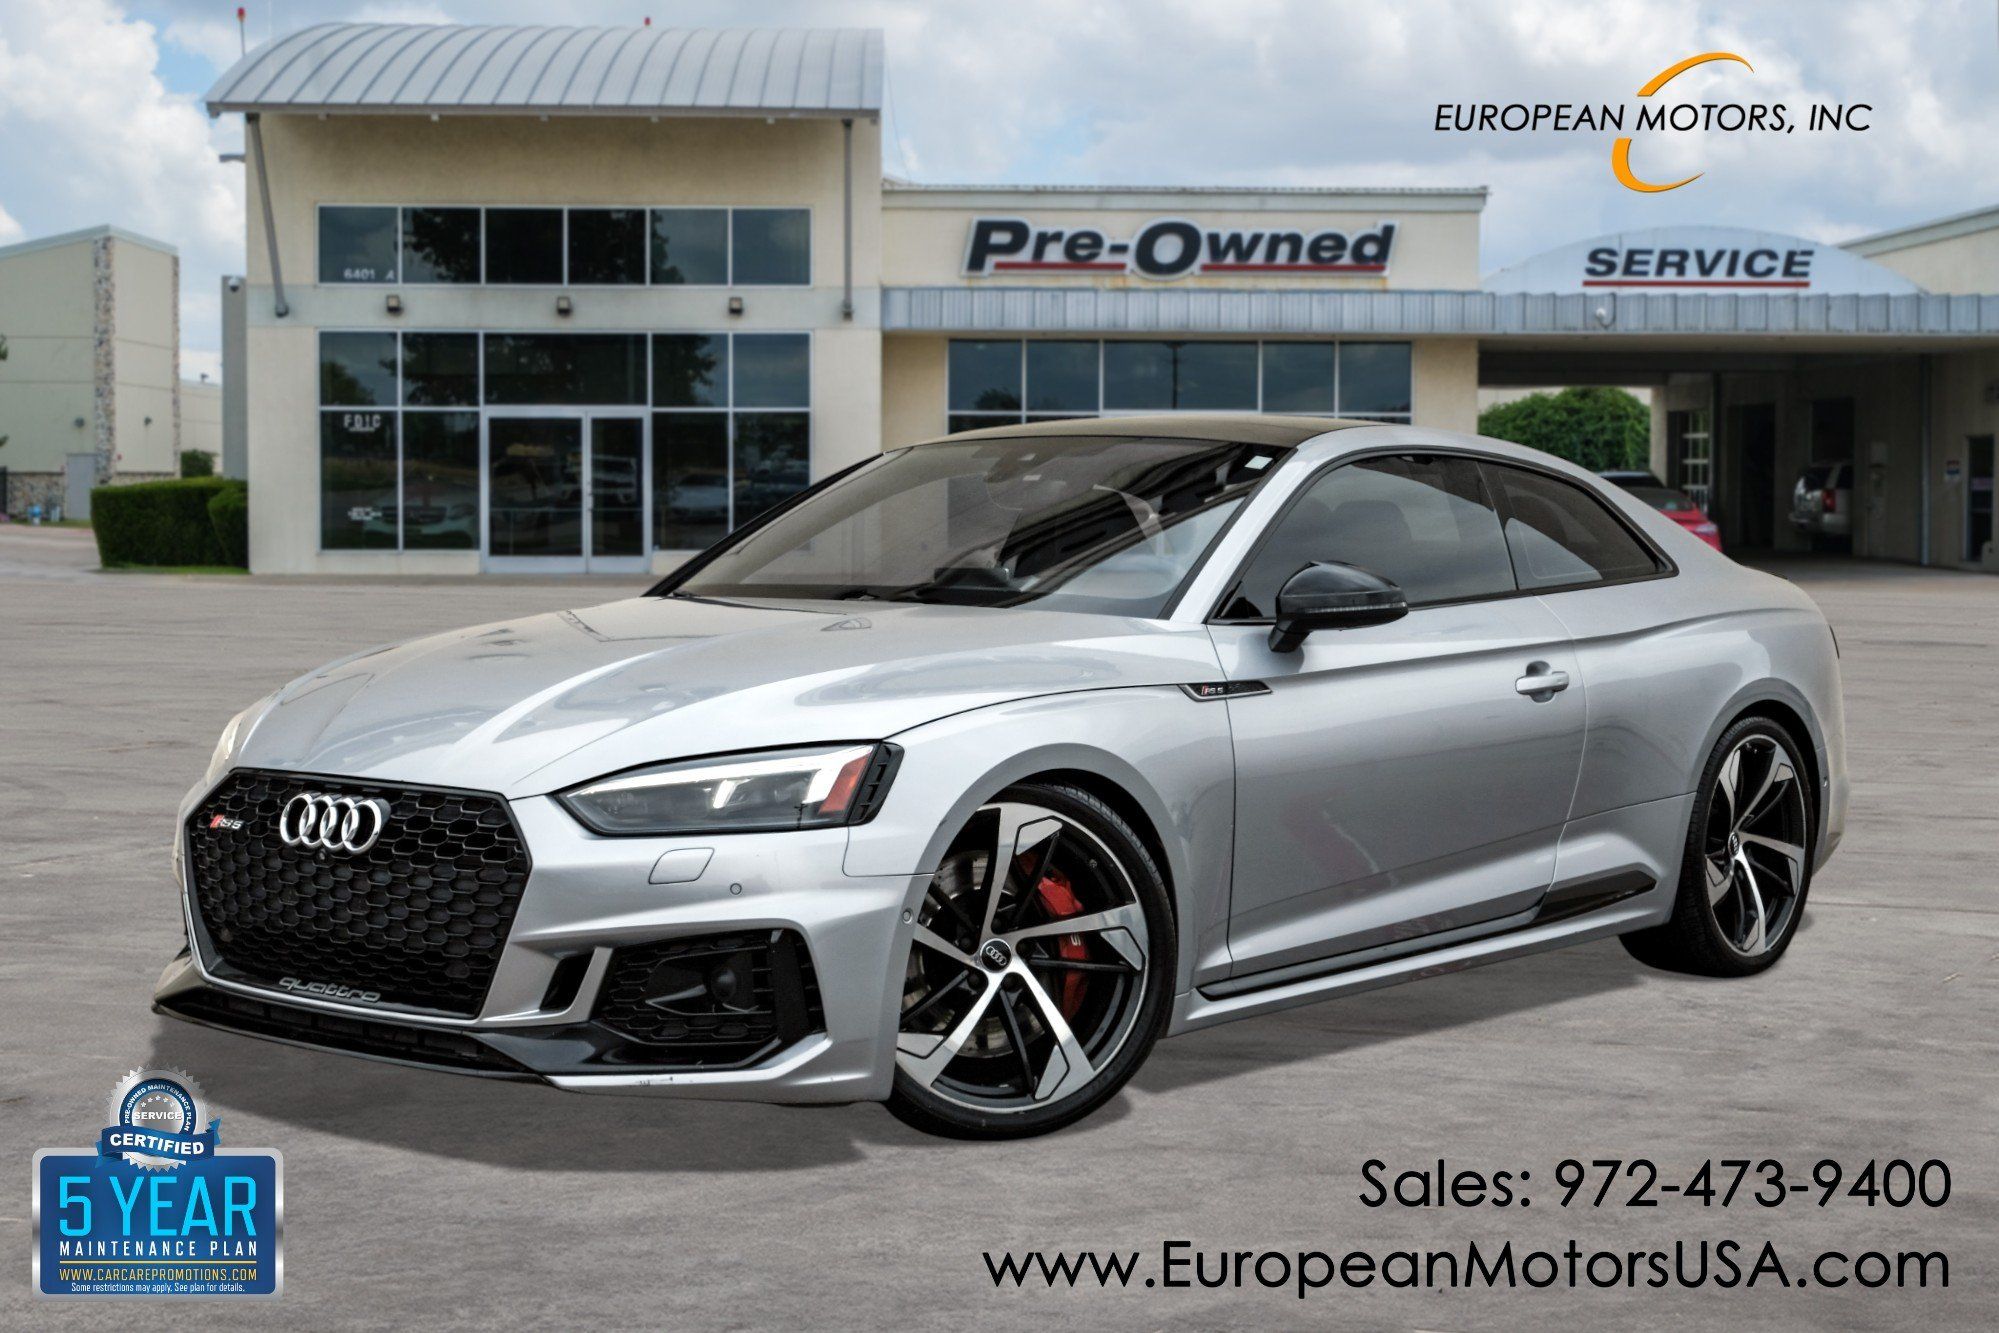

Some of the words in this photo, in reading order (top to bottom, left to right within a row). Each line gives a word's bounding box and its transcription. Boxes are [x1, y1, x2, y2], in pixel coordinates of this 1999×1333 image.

[967, 219, 1396, 276] Pre-Owned
[343, 268, 375, 280] 6401
[1585, 248, 1814, 278] SERVICE
[279, 977, 381, 1002] quattro
